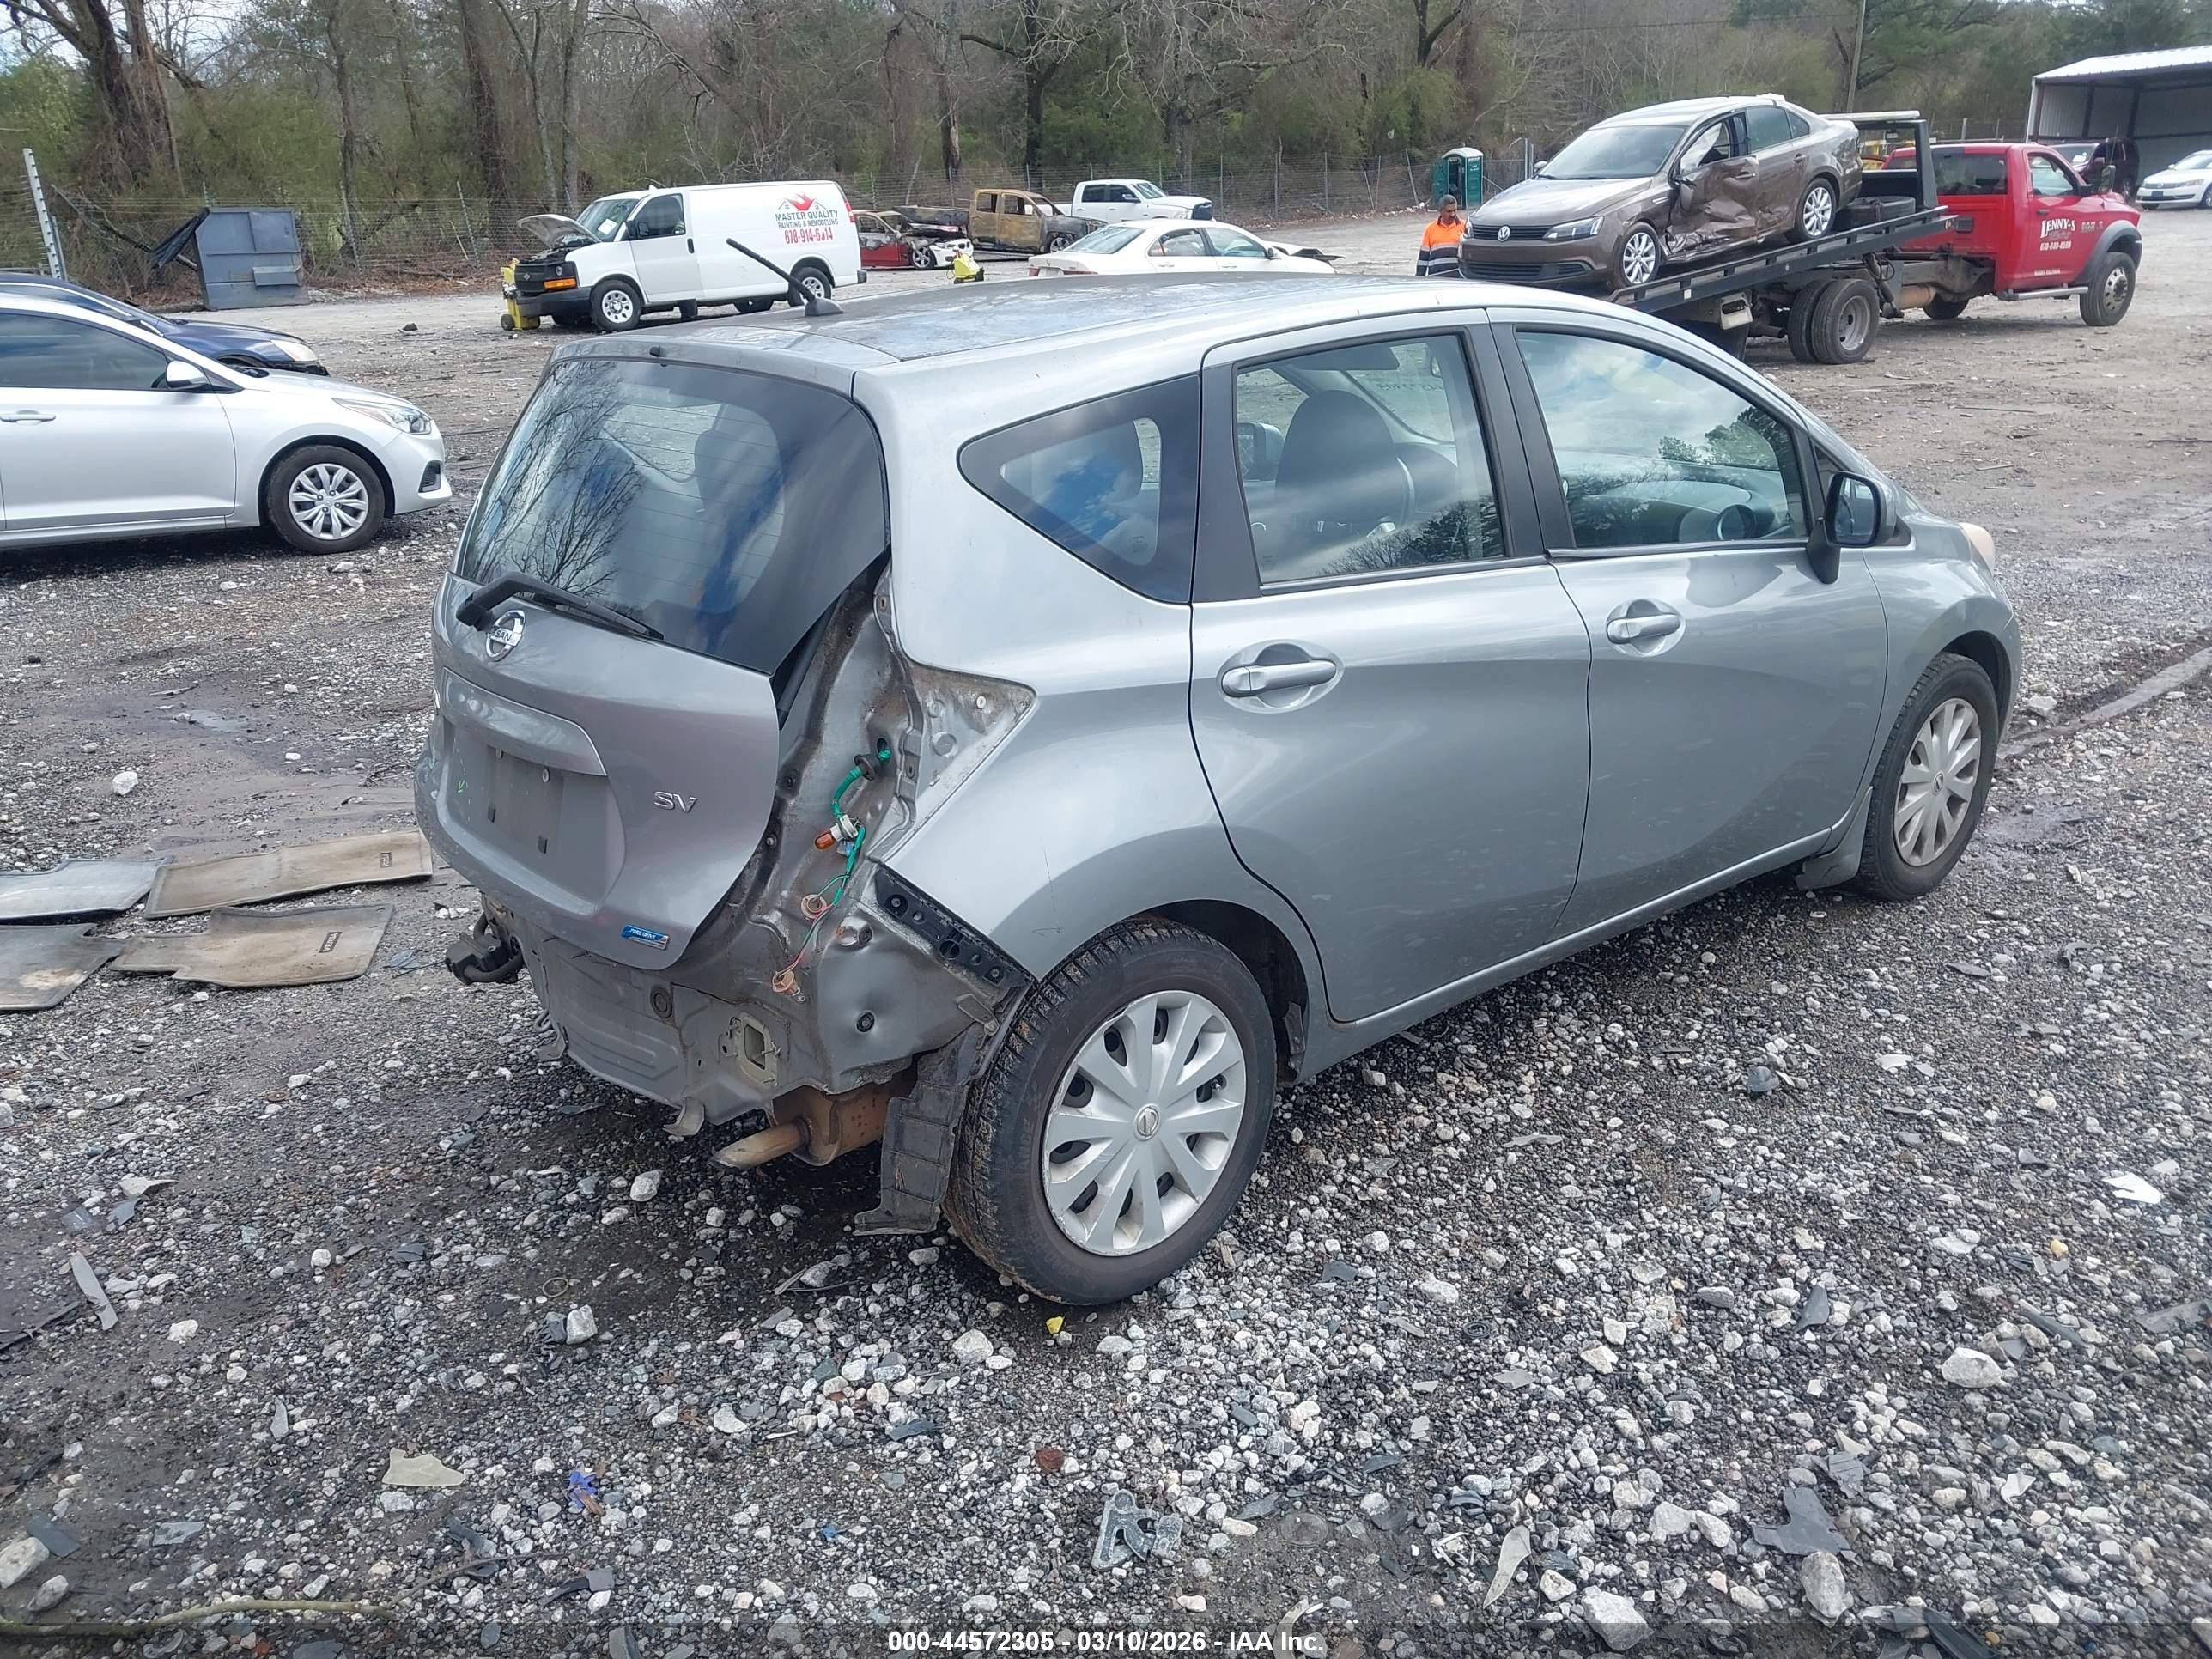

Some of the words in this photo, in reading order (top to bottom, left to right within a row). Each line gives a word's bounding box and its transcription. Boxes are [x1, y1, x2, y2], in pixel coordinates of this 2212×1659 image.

[775, 211, 805, 221] MASTER
[807, 210, 838, 220] QUALITY
[778, 221, 802, 229] PAINTING
[653, 791, 698, 813] SV
[641, 932, 657, 940] DRIVE
